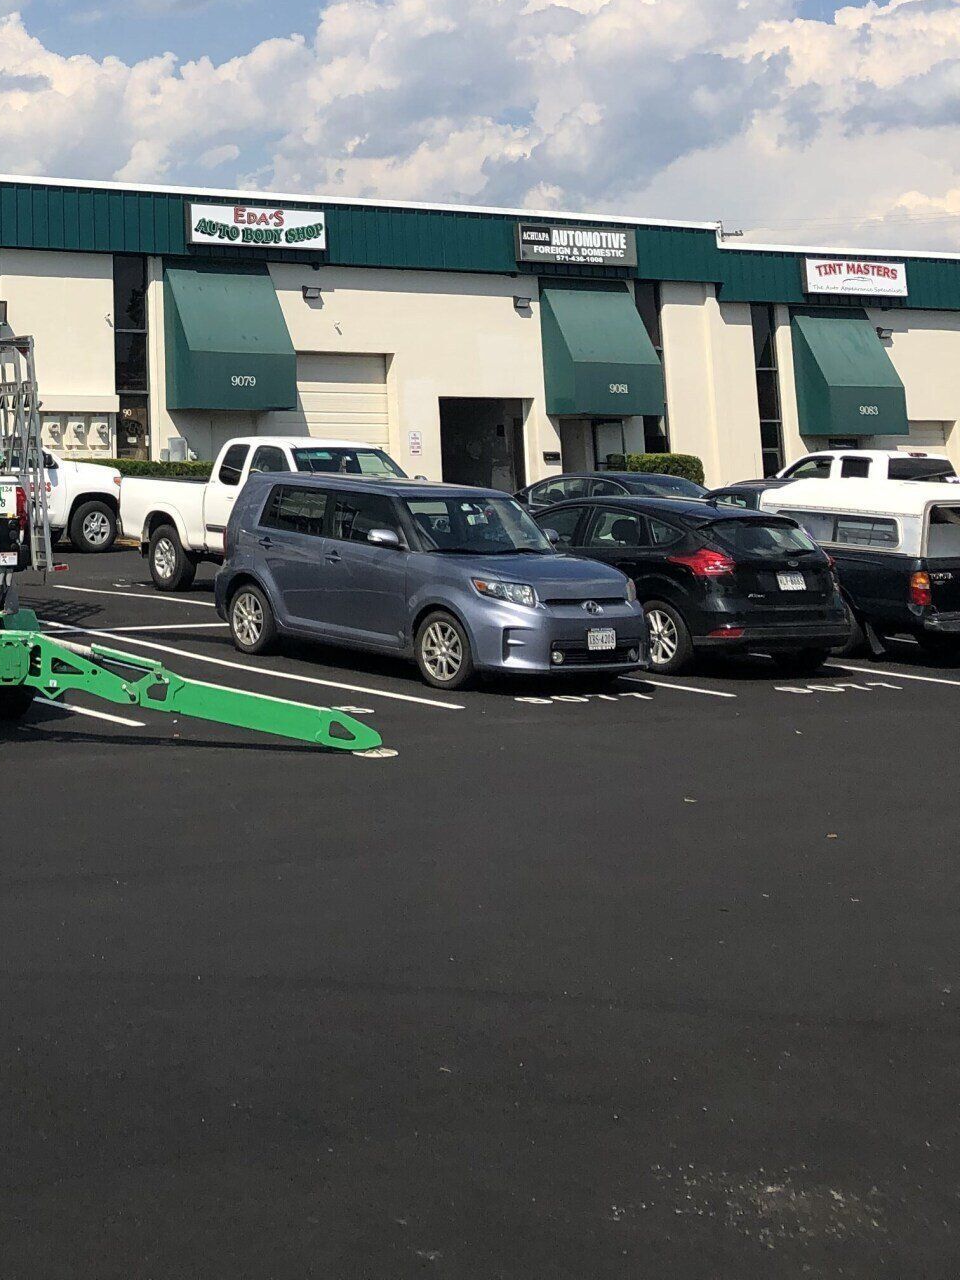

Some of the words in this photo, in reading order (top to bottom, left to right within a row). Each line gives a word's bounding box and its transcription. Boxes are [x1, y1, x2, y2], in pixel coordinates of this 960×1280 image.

[194, 218, 240, 241] AUTO
[241, 227, 284, 244] BODY
[284, 222, 323, 243] SHOP
[551, 229, 627, 249] AUTOMOTIVE
[533, 245, 571, 255] FOREIGN
[581, 248, 625, 257] DOMESTIC
[815, 263, 844, 277] TINT
[846, 263, 898, 280] MASTERS
[231, 375, 257, 387] 9079
[609, 383, 629, 394] 9081
